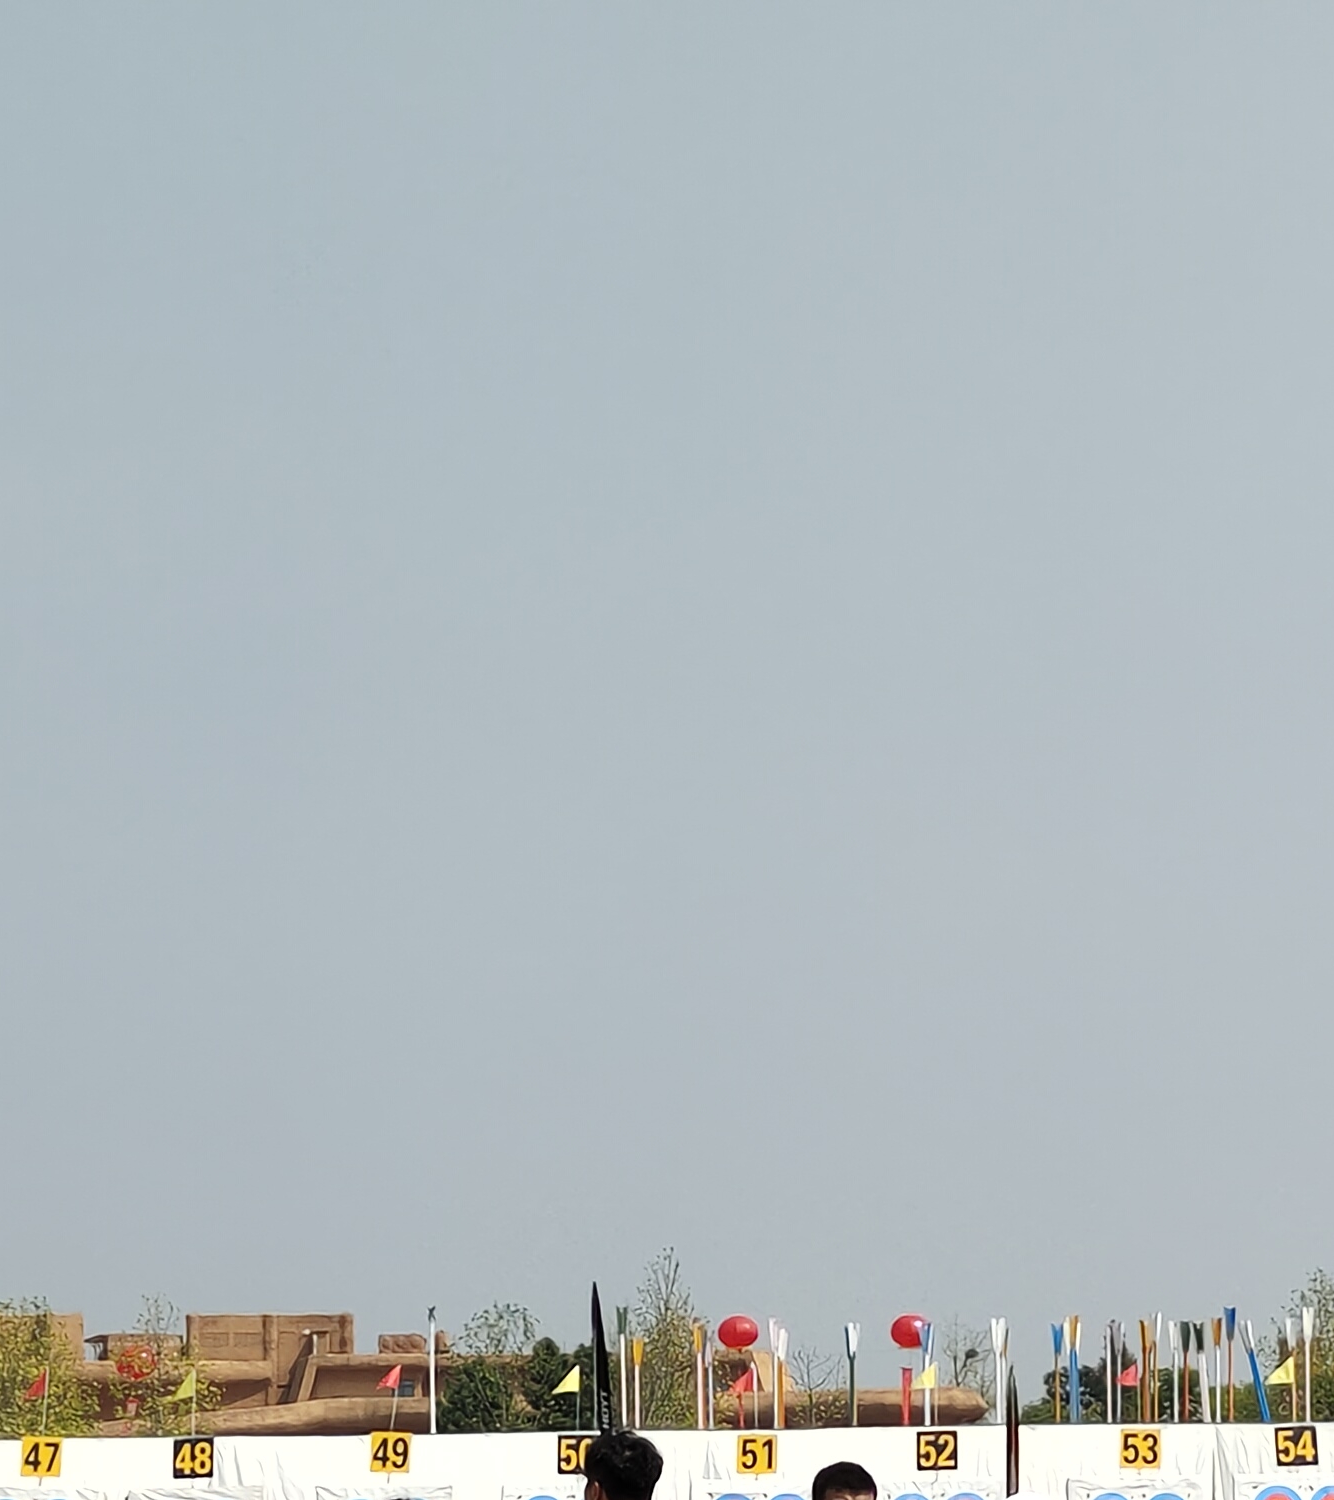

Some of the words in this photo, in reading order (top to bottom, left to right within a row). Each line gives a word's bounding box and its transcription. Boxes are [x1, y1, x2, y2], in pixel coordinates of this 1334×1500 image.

[24, 1442, 59, 1472] 47
[176, 1441, 211, 1475] 48
[373, 1437, 409, 1469] 49
[741, 1438, 773, 1470] 51
[920, 1434, 954, 1467] 52
[1123, 1433, 1158, 1465] 53
[1277, 1430, 1315, 1463] 54
